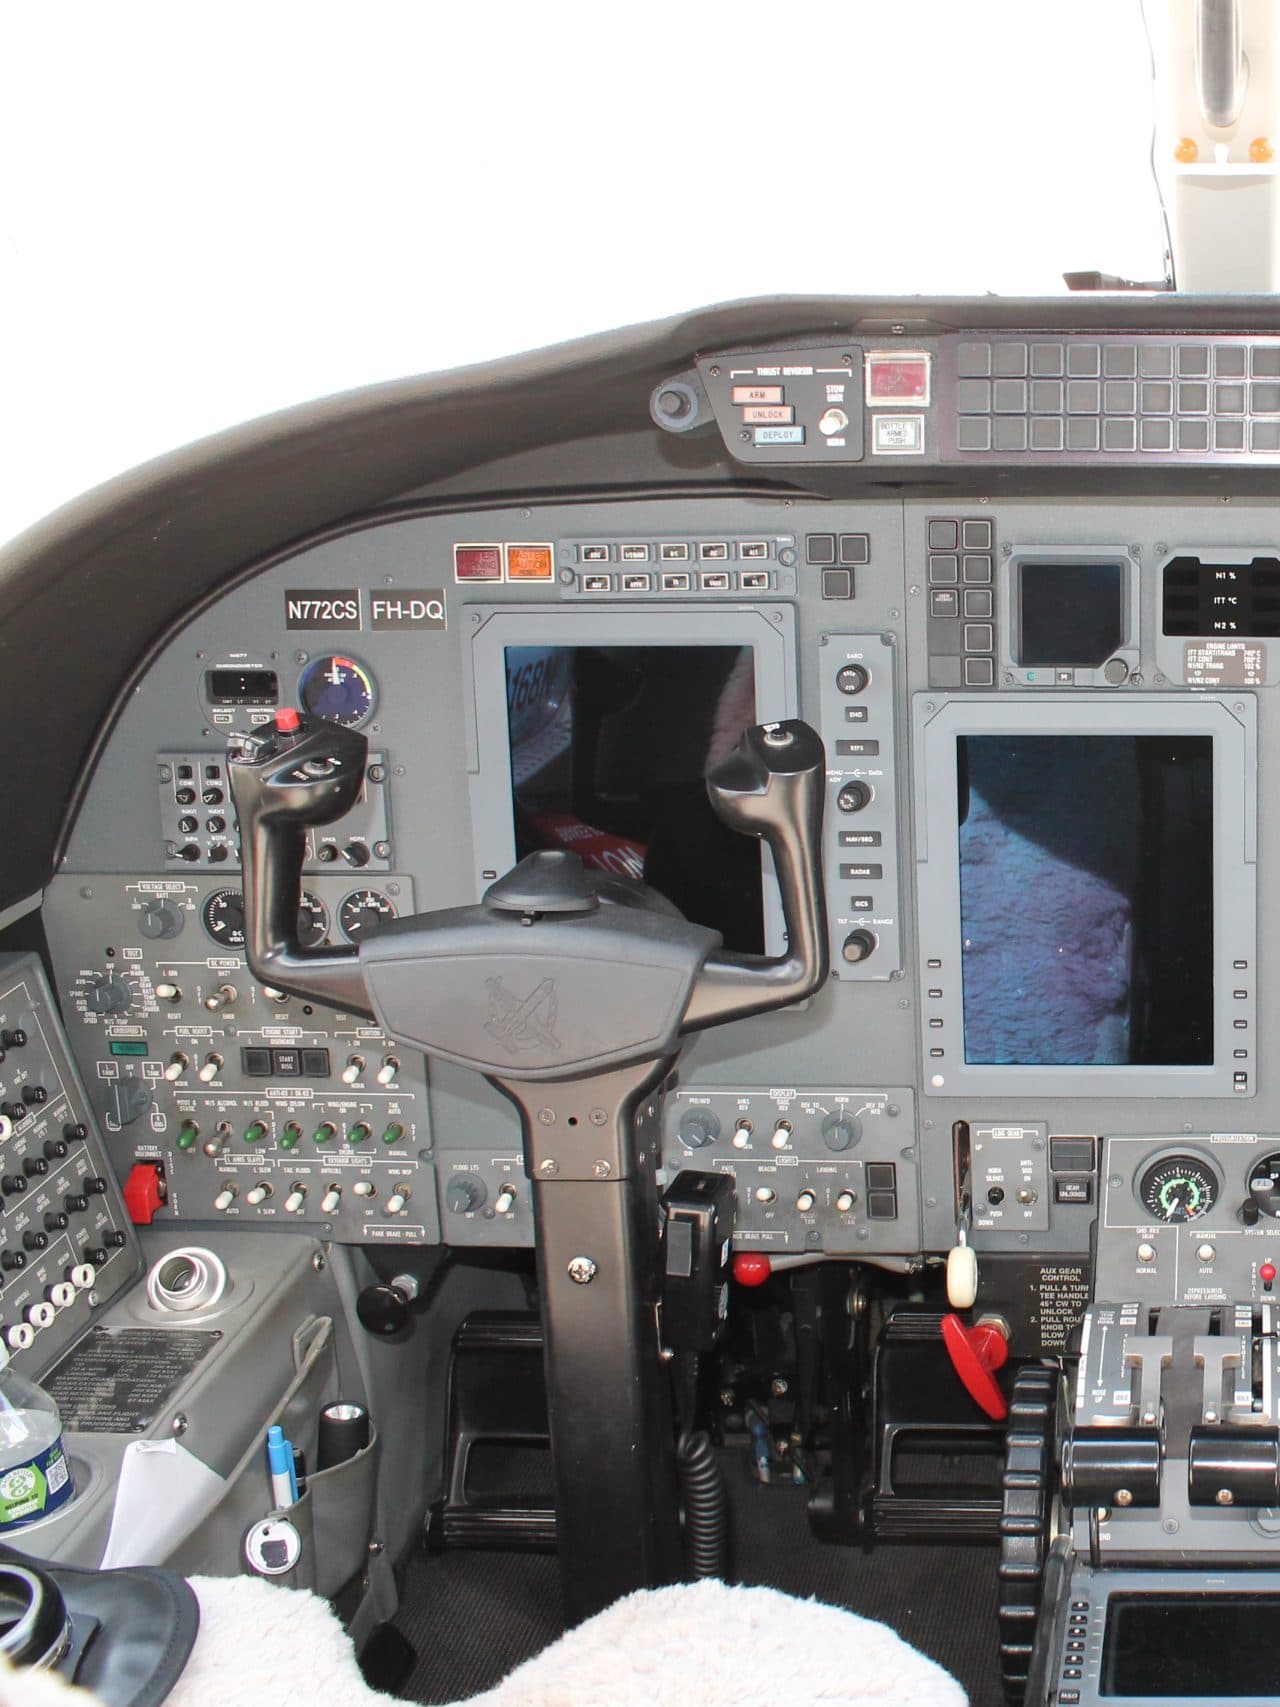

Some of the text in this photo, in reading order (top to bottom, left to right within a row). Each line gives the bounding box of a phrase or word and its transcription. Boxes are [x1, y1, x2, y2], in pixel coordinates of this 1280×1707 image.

[752, 410, 783, 418] UNLOCK
[764, 431, 793, 439] DEPLOY
[288, 601, 357, 620] N772CS
[373, 601, 444, 620] FH-DQ
